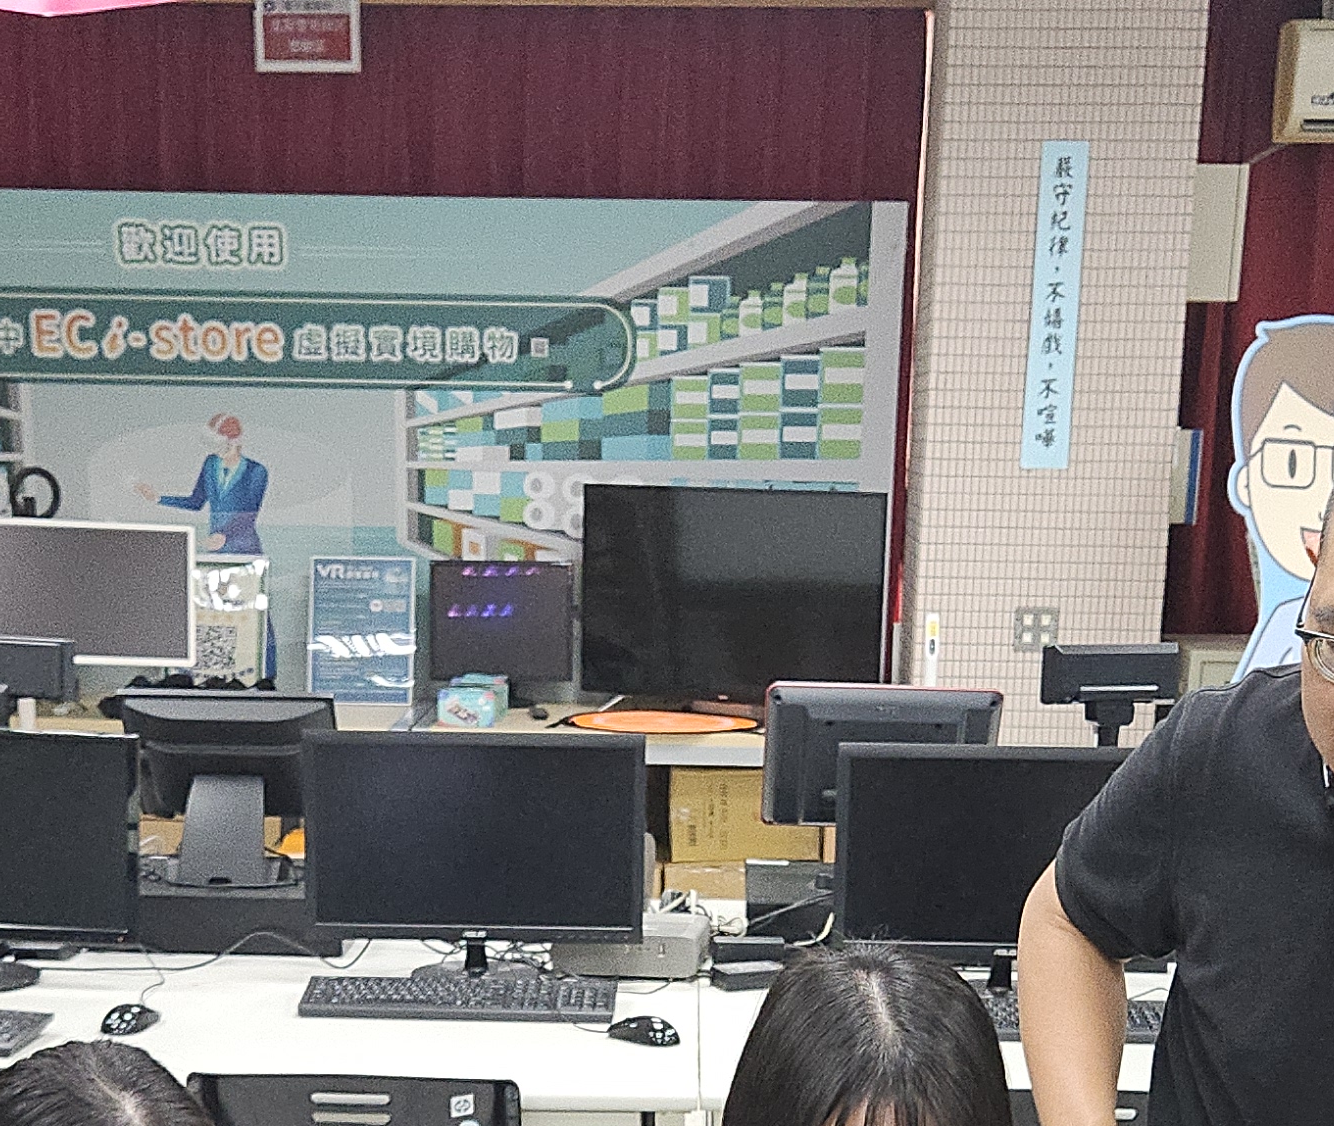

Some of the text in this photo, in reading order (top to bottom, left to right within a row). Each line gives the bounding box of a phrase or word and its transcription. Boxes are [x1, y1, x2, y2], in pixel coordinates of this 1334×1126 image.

[120, 225, 284, 267] 歡迎使用
[31, 307, 97, 359] EC
[104, 311, 285, 363] i-store
[293, 321, 519, 364] 虛擬實境購物
